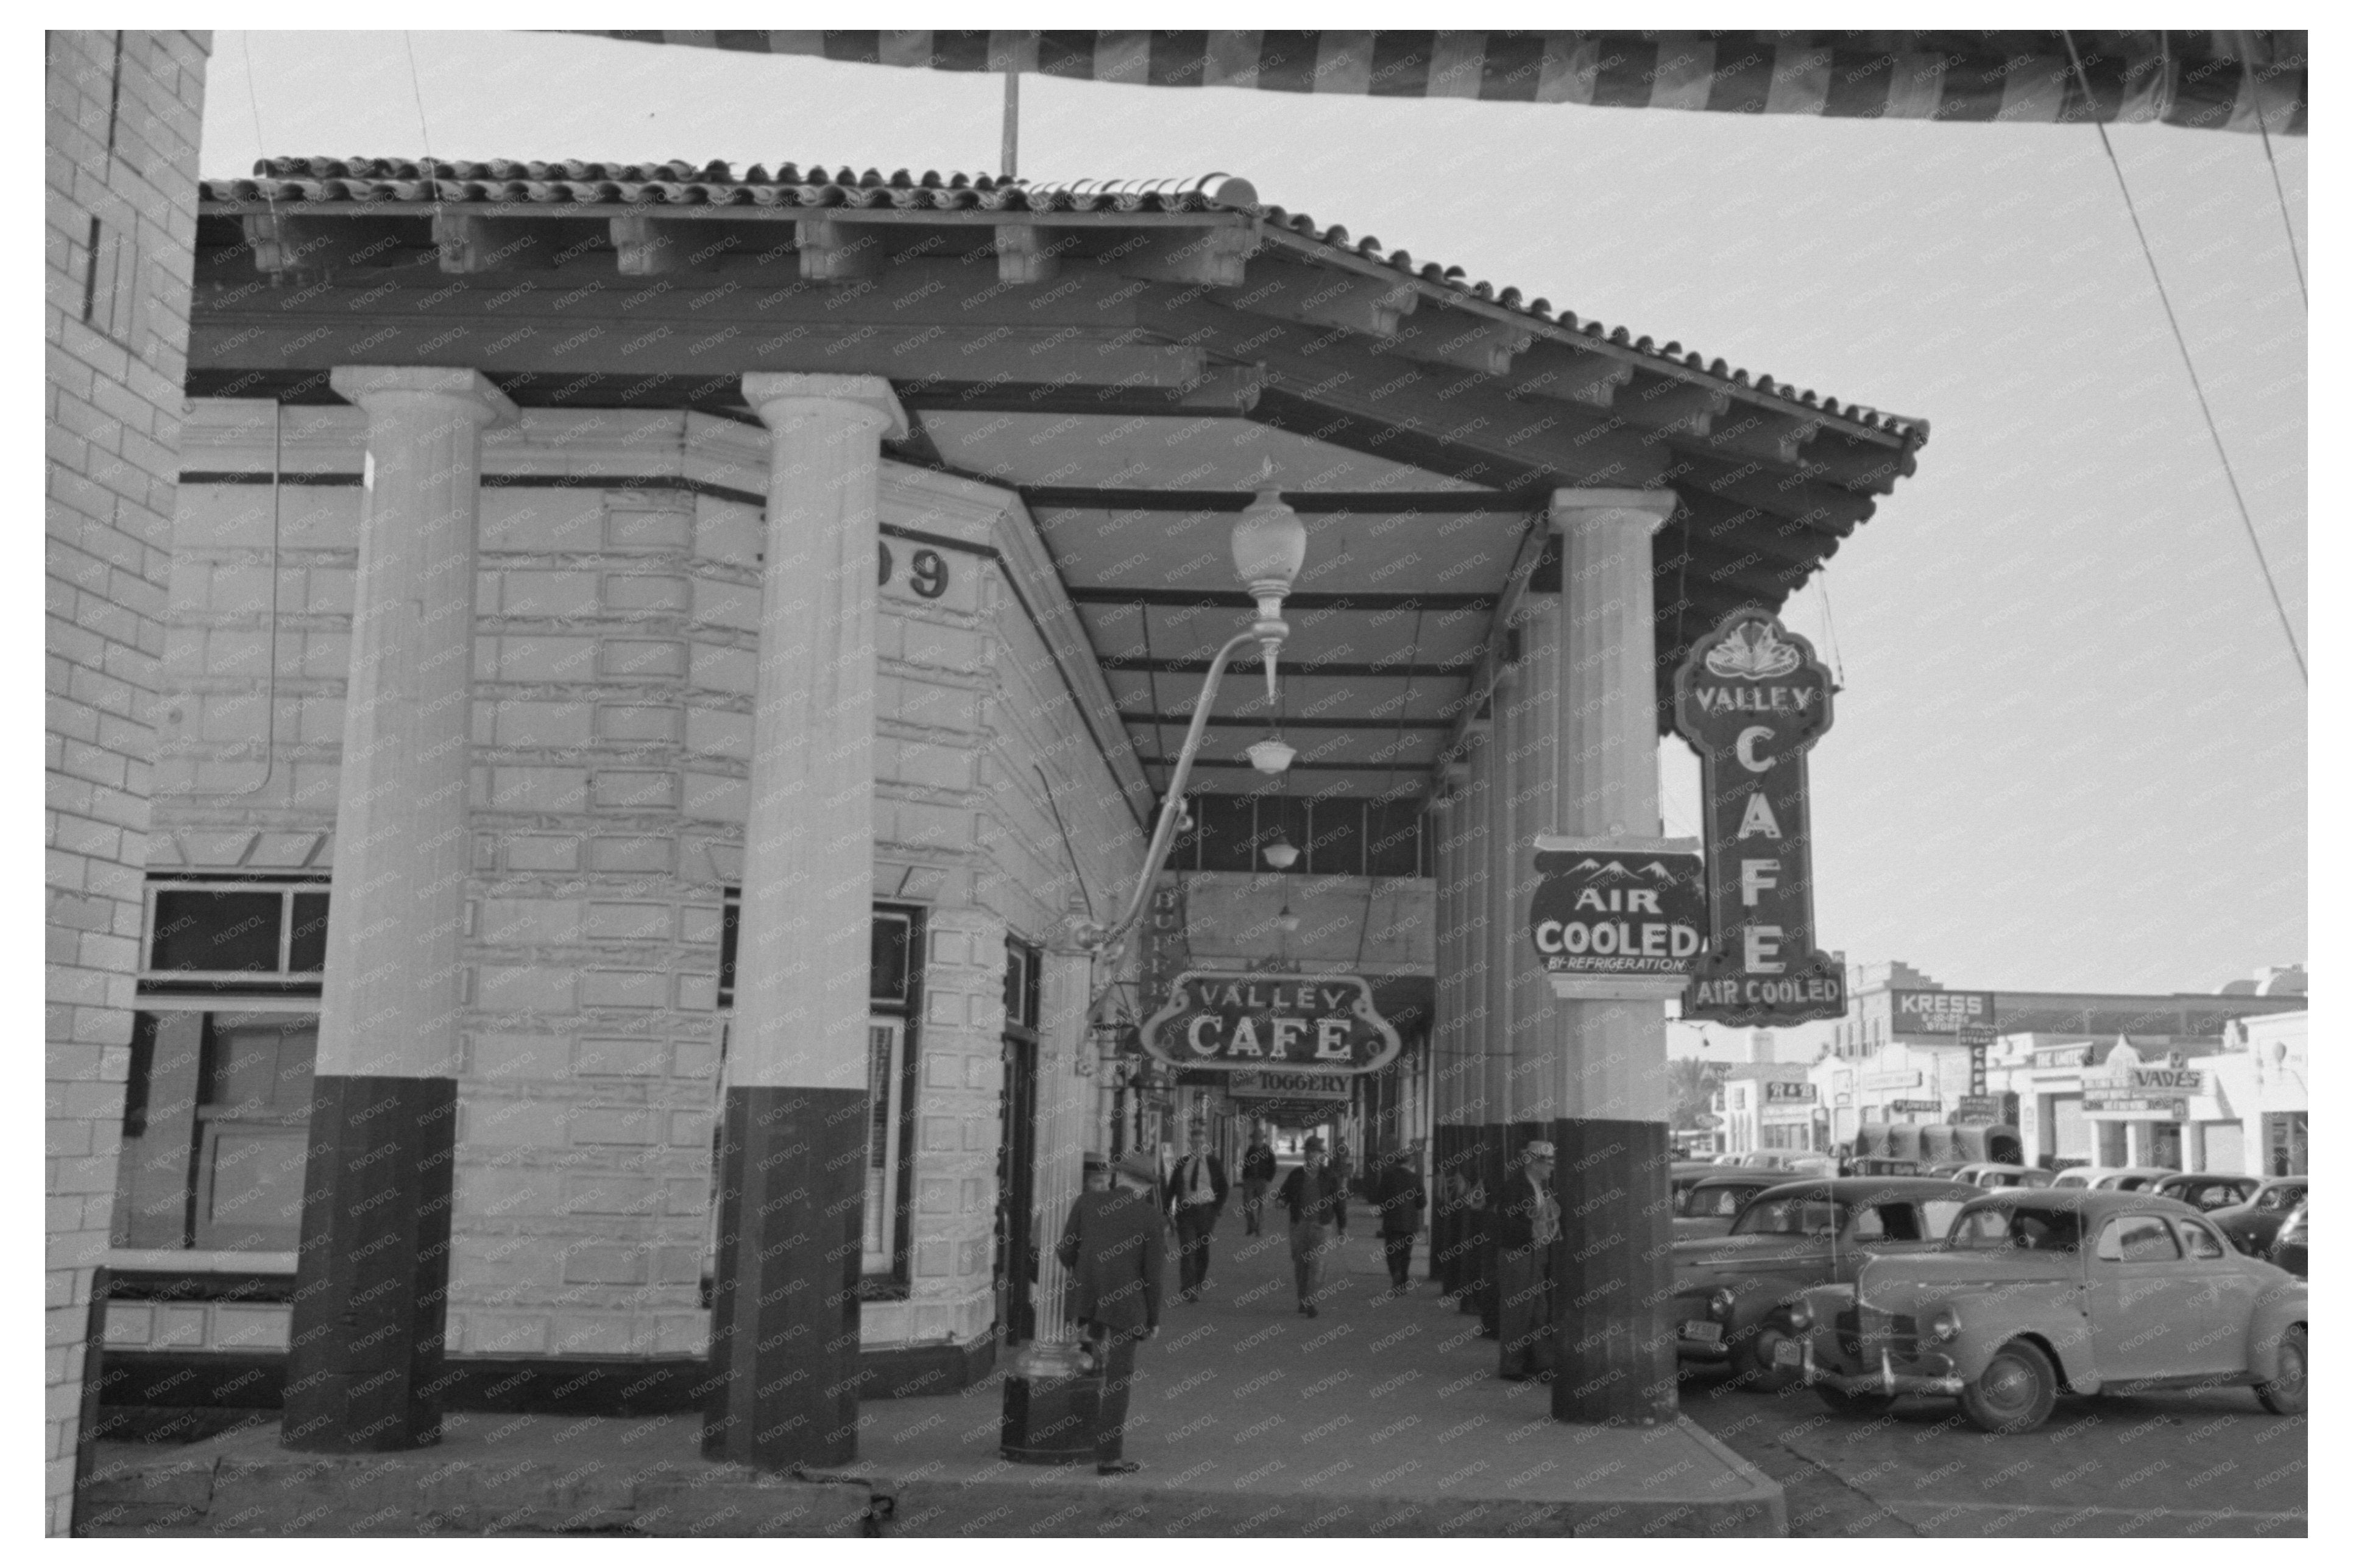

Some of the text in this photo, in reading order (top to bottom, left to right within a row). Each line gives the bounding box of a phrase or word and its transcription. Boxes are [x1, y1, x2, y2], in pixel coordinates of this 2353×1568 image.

[1696, 685, 1815, 712] VALLEY
[1736, 726, 1786, 973] CAFE
[1574, 888, 1663, 914] AIR
[1536, 920, 1700, 958] COOLED
[1548, 956, 1688, 972] BY-REFRIGERATION
[1199, 984, 1347, 1010] VALLEY
[1696, 980, 1840, 1005] AIR COOLED
[1901, 994, 1983, 1015] KRESS
[1187, 1015, 1353, 1060] CAFE
[1258, 1071, 1351, 1092] TOGGERY
